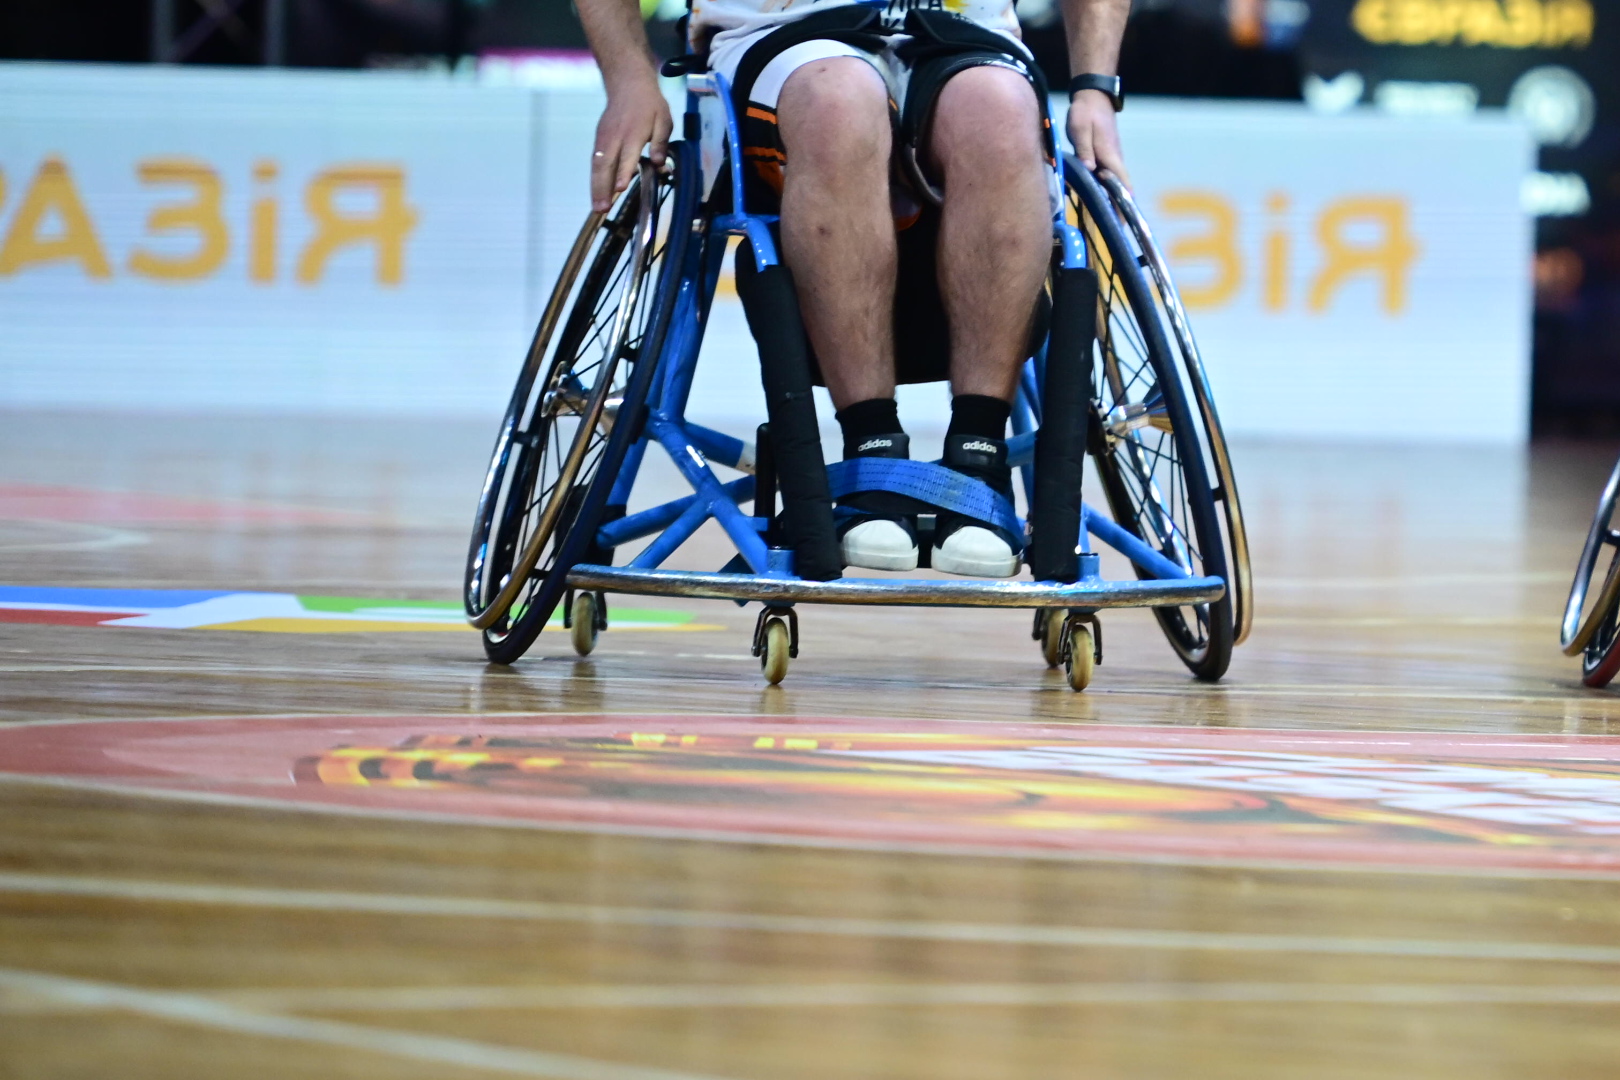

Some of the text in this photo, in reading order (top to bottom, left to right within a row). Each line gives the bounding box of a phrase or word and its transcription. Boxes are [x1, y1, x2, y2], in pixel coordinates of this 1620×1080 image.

[0, 153, 418, 287] АЗіЯ
[858, 438, 892, 451] adidas
[962, 441, 997, 453] adidas
